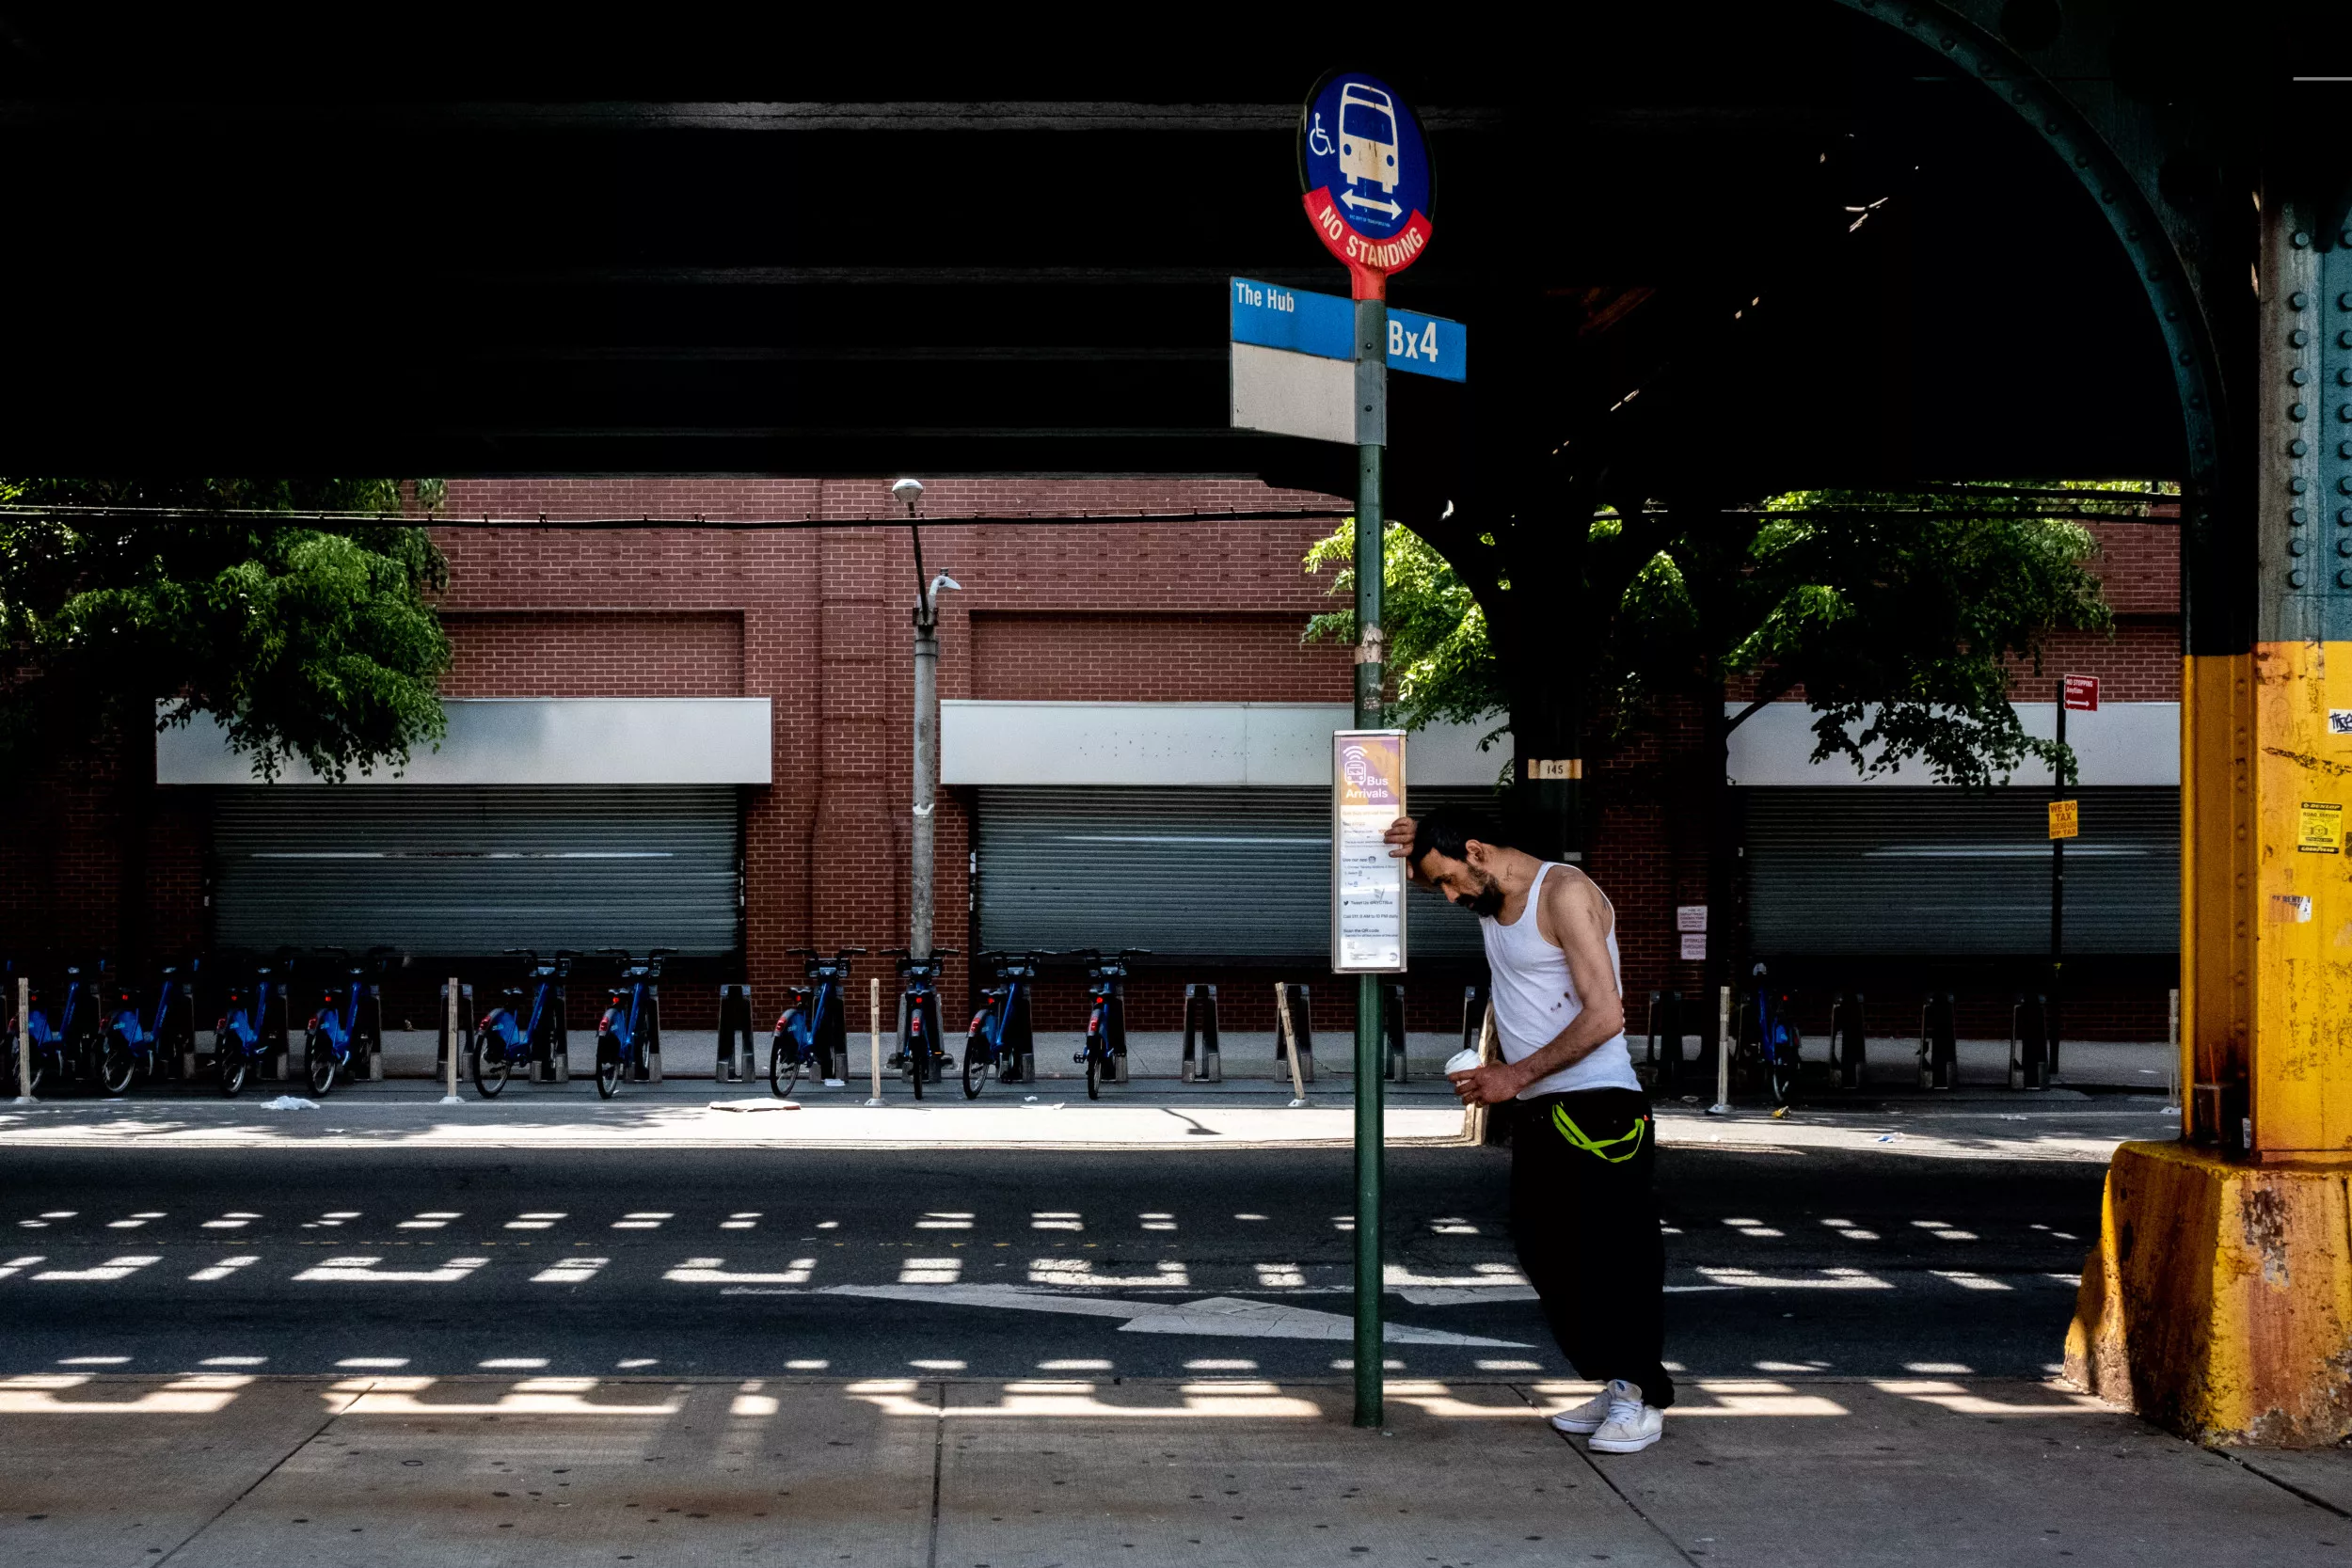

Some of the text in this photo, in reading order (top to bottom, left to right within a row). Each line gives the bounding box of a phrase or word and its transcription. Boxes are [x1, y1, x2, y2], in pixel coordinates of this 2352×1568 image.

[1319, 205, 1343, 241] NO
[1235, 281, 1295, 312] The Hub
[1389, 319, 1438, 363] Bx4
[2073, 679, 2093, 688] STOPPING
[2066, 686, 2084, 695] Anytime
[1547, 765, 1564, 775] 145
[1367, 775, 1389, 786] Bus
[1345, 787, 1389, 799] Arrivals
[2050, 802, 2076, 813] WE DO
[2055, 812, 2072, 822] TAX
